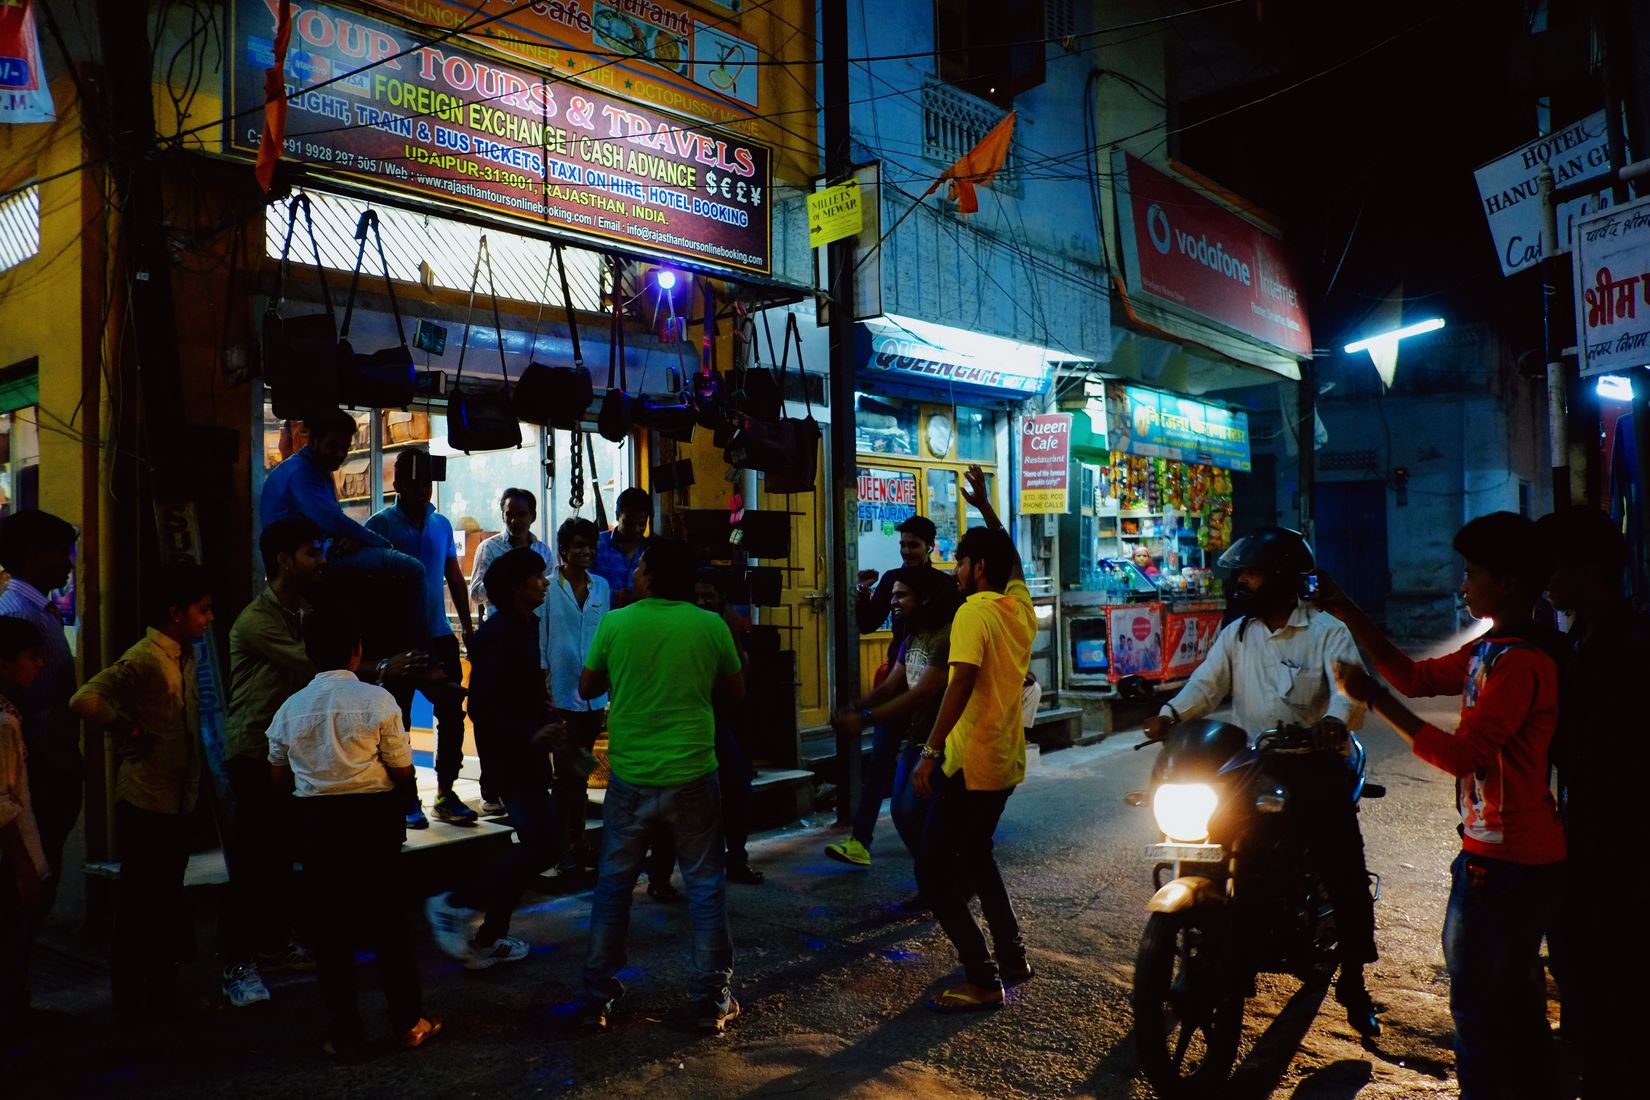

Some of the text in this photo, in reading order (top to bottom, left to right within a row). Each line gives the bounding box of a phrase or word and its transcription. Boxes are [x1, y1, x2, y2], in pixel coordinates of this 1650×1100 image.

[264, 0, 755, 178] YOUR TOURS & TRAVELS
[403, 1, 760, 136] LUNCH DINNER WIFI OCTOPUSSY MOVIE
[285, 84, 749, 228] LIGHT, TRAIN & BUS TICKETS, TAXI ON HIRE, HOTEL BOOKING
[375, 74, 464, 125] FOREIGN
[469, 103, 567, 156] EXCHANGE
[580, 135, 624, 172] CASH
[626, 150, 697, 190] ADVANCE
[1521, 125, 1589, 170] HOTEL
[282, 138, 302, 152] +91
[305, 143, 333, 162] 9928
[335, 149, 354, 167] 297
[357, 155, 377, 173] 505
[385, 161, 408, 180] Web
[417, 173, 592, 226] www.rajasthantoursonlinebooking.com
[598, 217, 621, 232] Email
[626, 224, 763, 266] info@rajasthantoursonlinebooking.com
[405, 144, 669, 225] UDAIPUR-313001, RAJASTHAN, INDIA.
[1485, 155, 1584, 216] HANUAN
[1174, 228, 1250, 286] vodafone
[1023, 420, 1067, 436] Queen
[1031, 435, 1059, 451] Cafe
[1024, 454, 1065, 464] Restaurant
[856, 476, 916, 505] UEEN CAFE
[857, 504, 916, 521] ESTAURANT
[1044, 501, 1064, 509] CALLS
